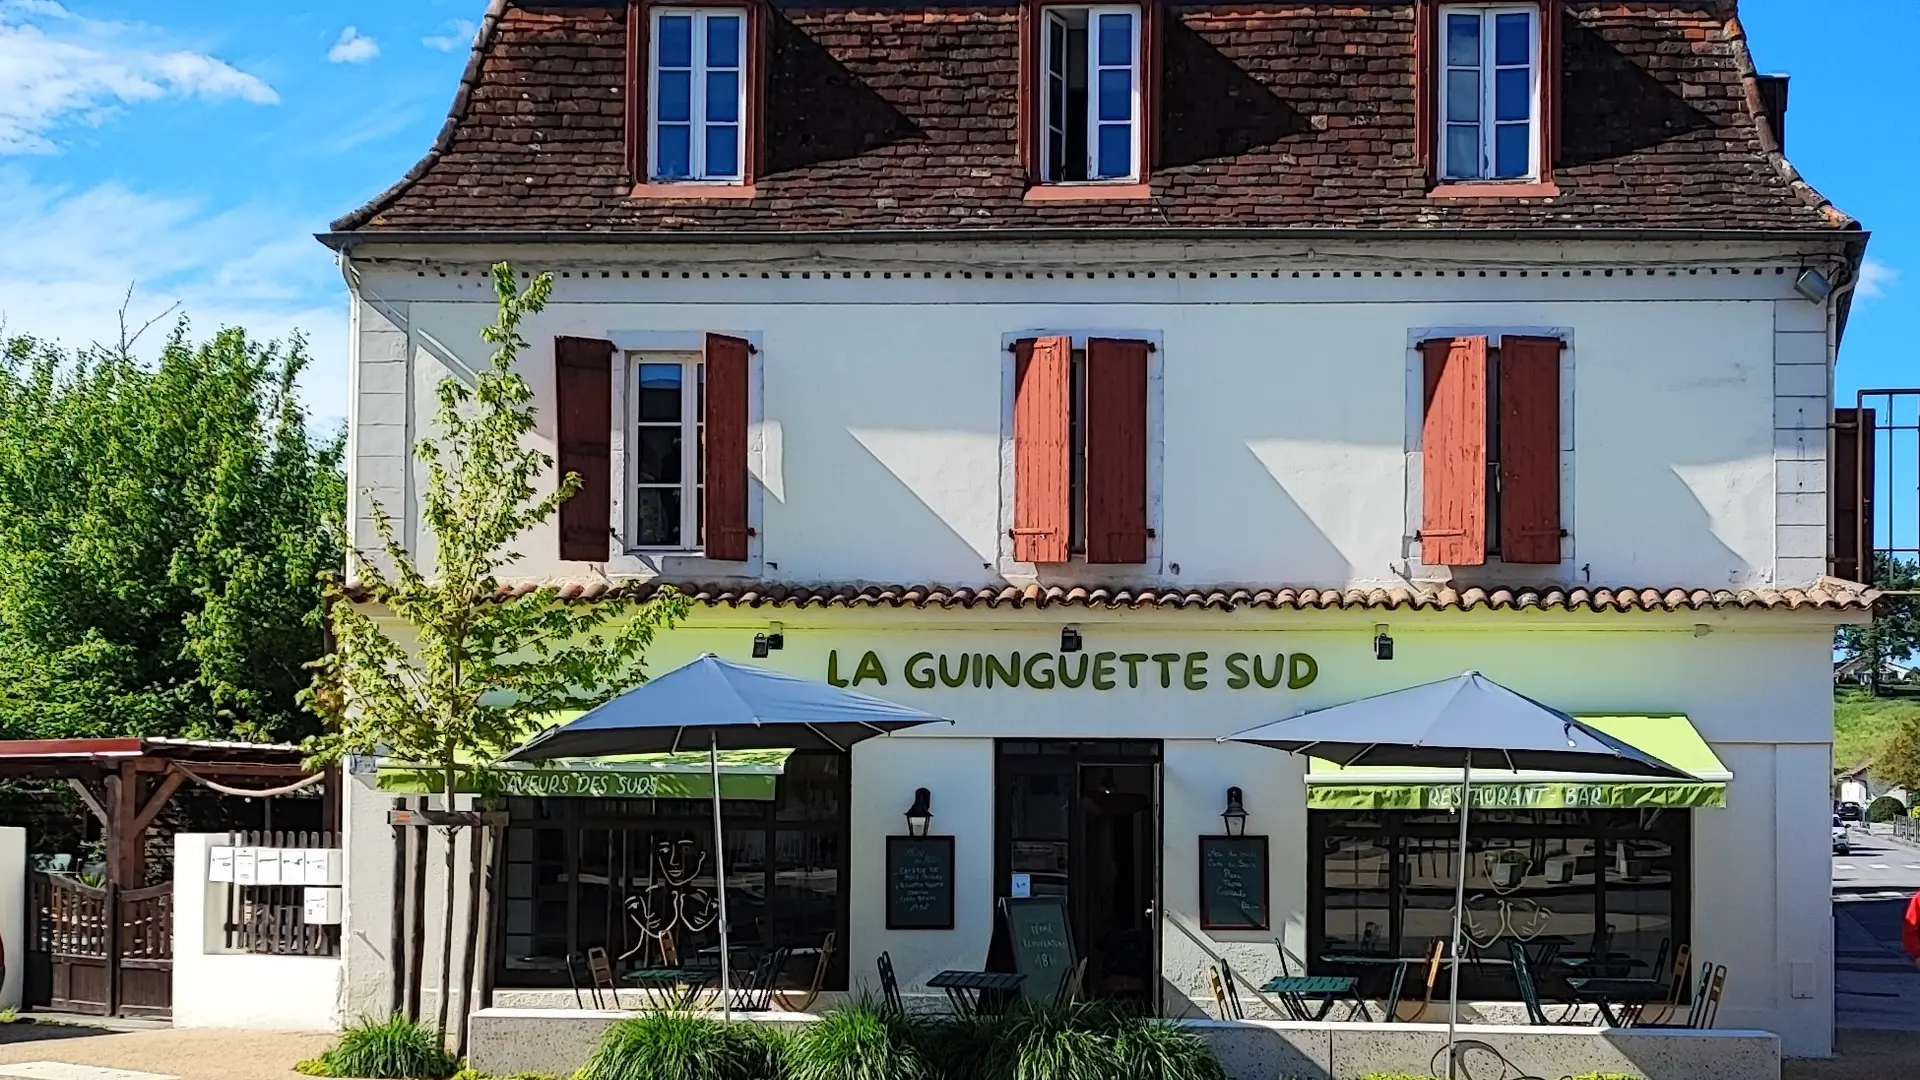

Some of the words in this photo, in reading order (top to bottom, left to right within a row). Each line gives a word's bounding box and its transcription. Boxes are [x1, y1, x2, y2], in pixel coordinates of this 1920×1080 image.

[827, 649, 888, 688] LA
[904, 650, 1208, 690] GUINGUETTE
[1225, 652, 1318, 690] SUD
[499, 774, 570, 794] SAVEURS
[577, 775, 609, 794] DES
[1428, 786, 1549, 806] RESAURANT
[1566, 786, 1601, 806] BAR
